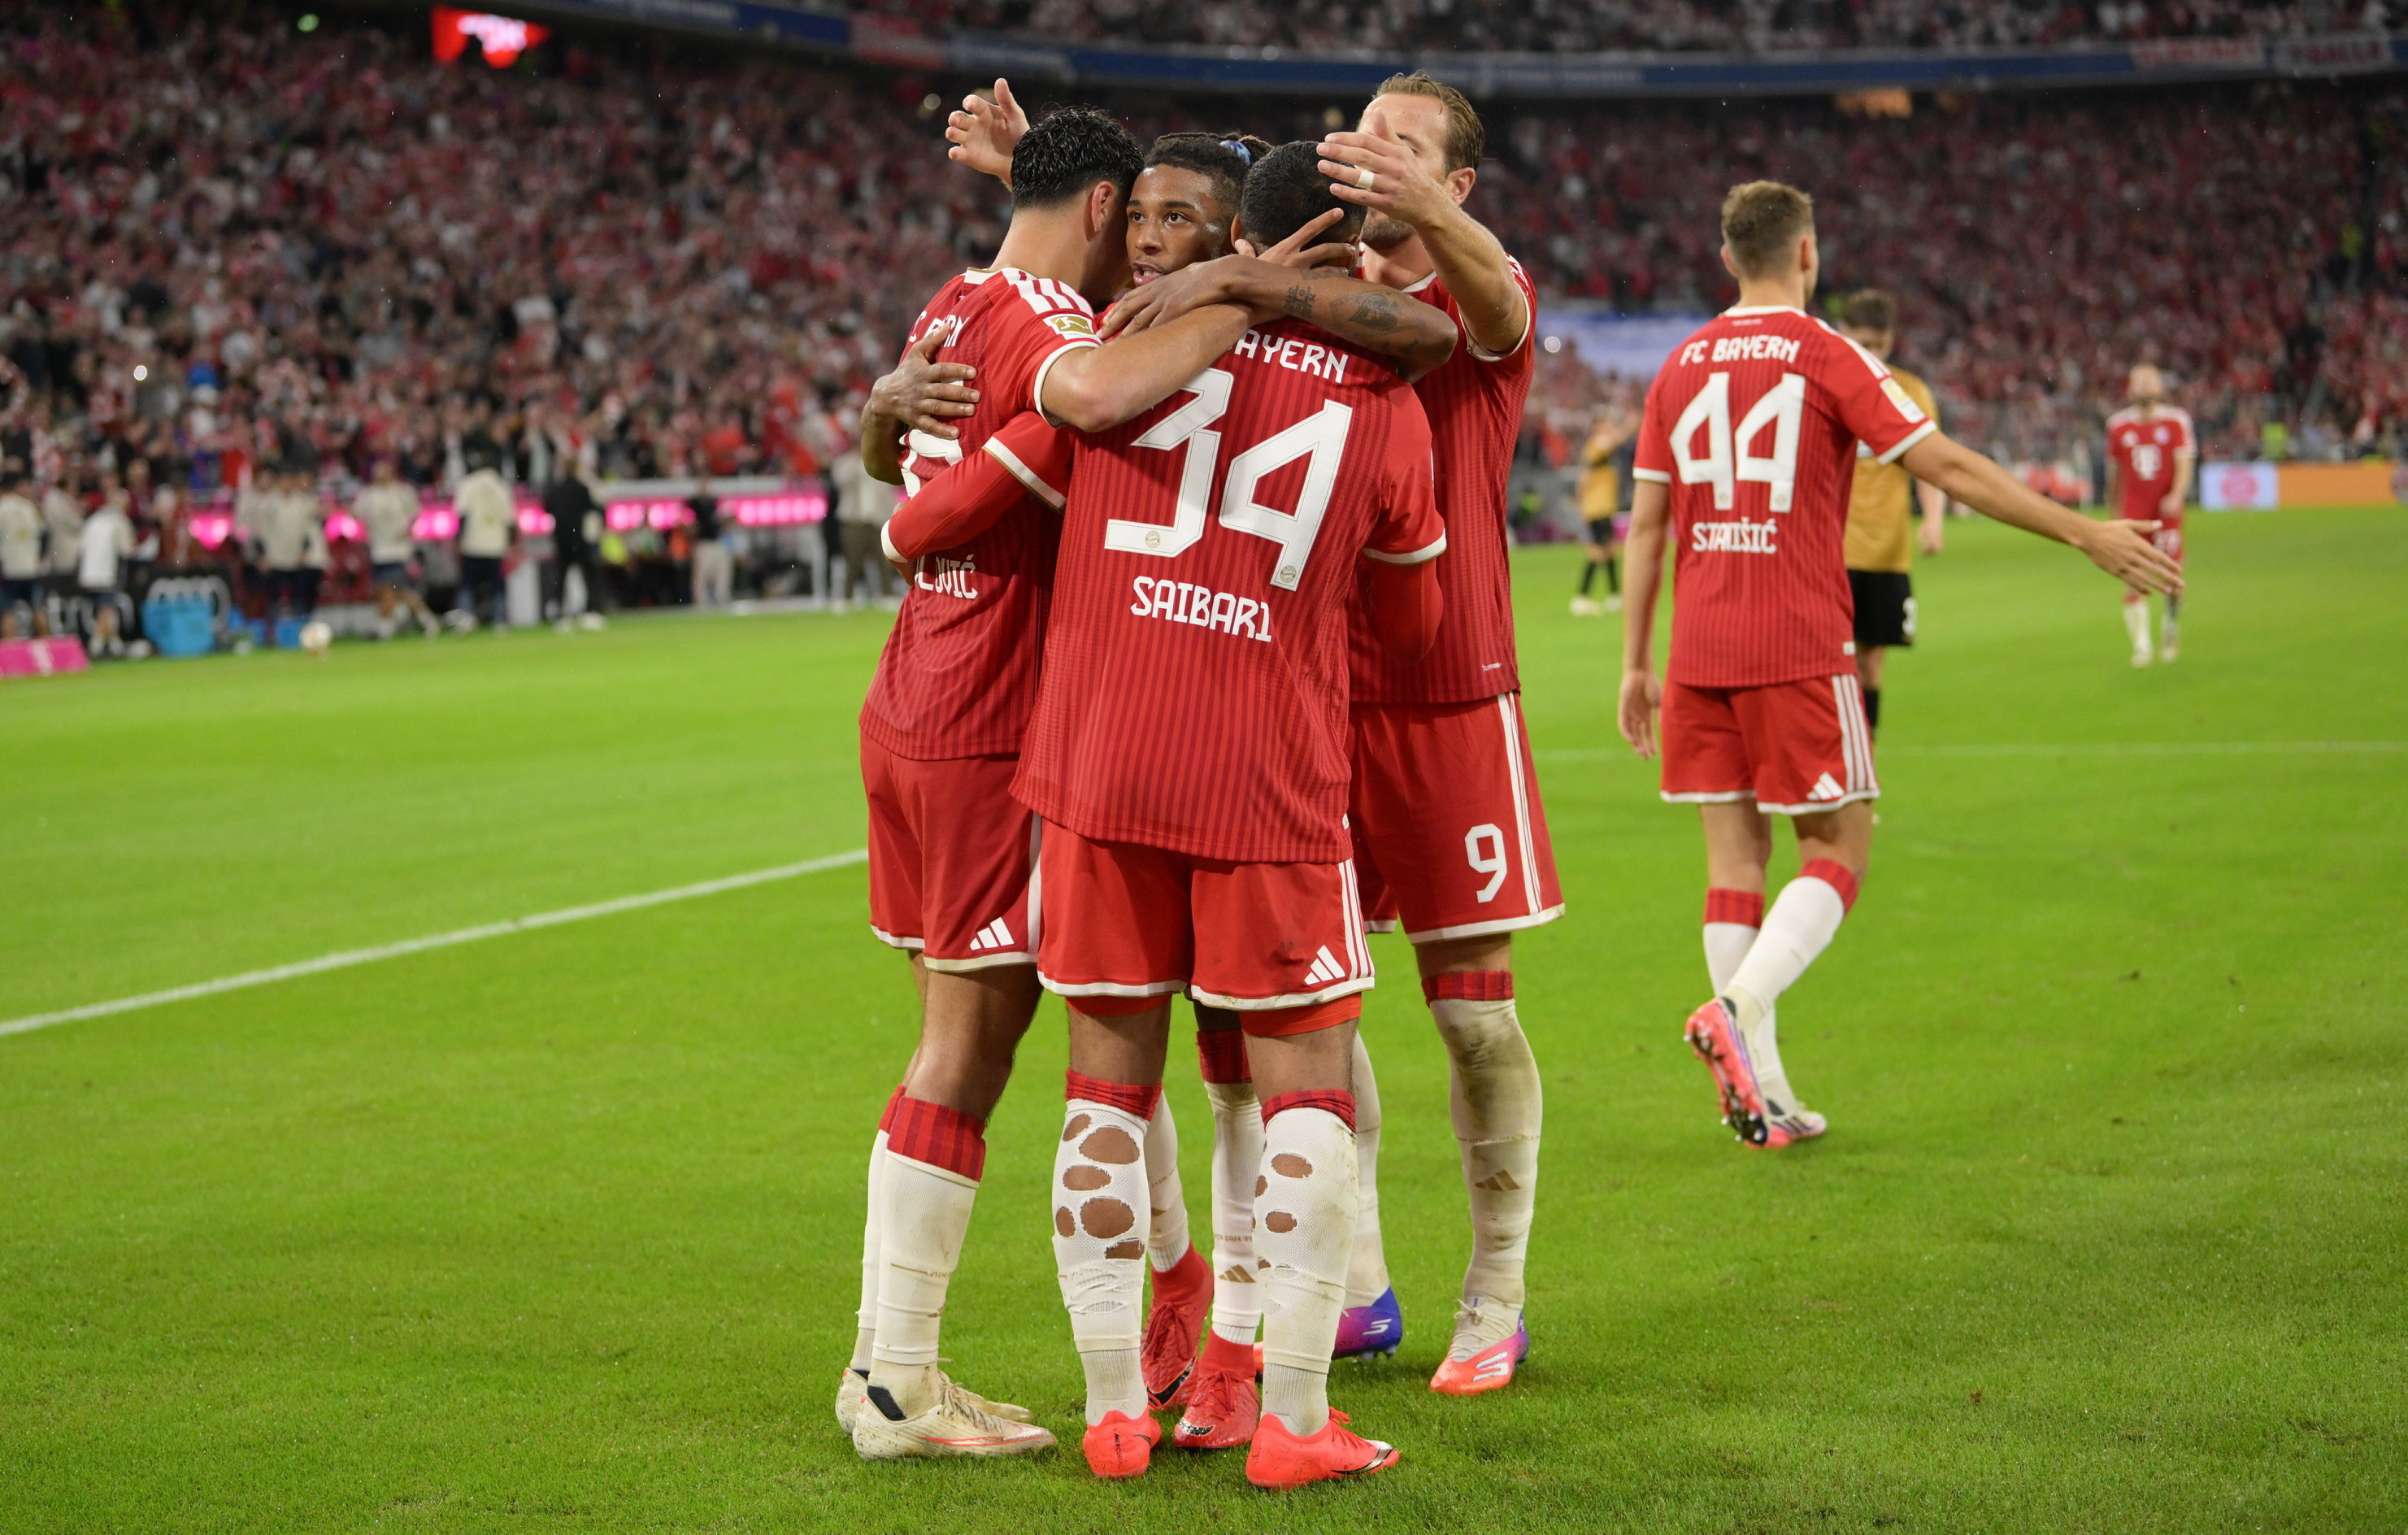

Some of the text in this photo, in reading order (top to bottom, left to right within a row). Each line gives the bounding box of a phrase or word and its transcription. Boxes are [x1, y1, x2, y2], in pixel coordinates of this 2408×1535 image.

[1228, 329, 1350, 384] AYERN
[1680, 334, 1801, 367] FC BAYERN
[1669, 372, 1806, 513] 44
[1104, 366, 1354, 593] 34
[1131, 576, 1272, 642] SAIBARI
[1465, 823, 1507, 903] 9
